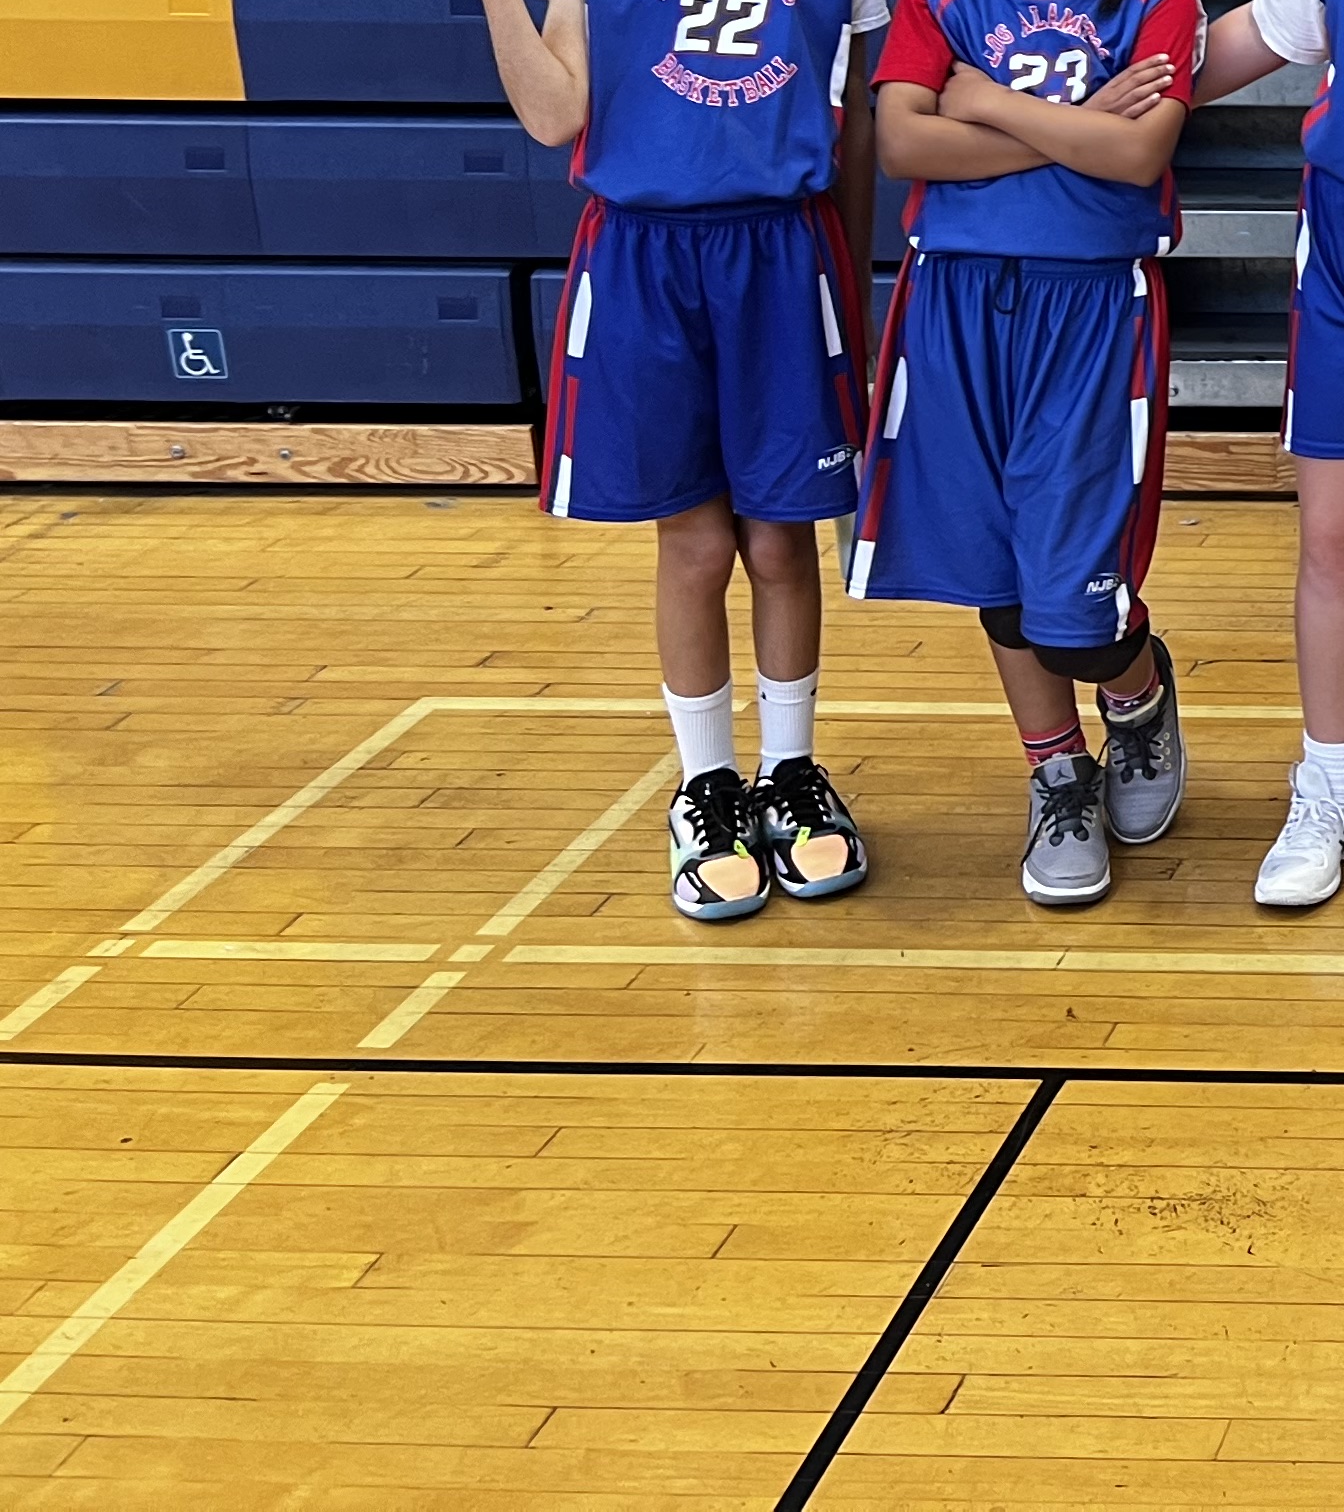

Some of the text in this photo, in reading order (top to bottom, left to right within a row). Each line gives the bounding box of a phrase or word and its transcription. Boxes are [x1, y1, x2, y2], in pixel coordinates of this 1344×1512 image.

[982, 23, 1016, 68] LOS
[651, 52, 799, 107] BASKETBALL
[1008, 49, 1089, 104] 23
[817, 450, 846, 469] NJB
[1086, 578, 1114, 593] NJB
